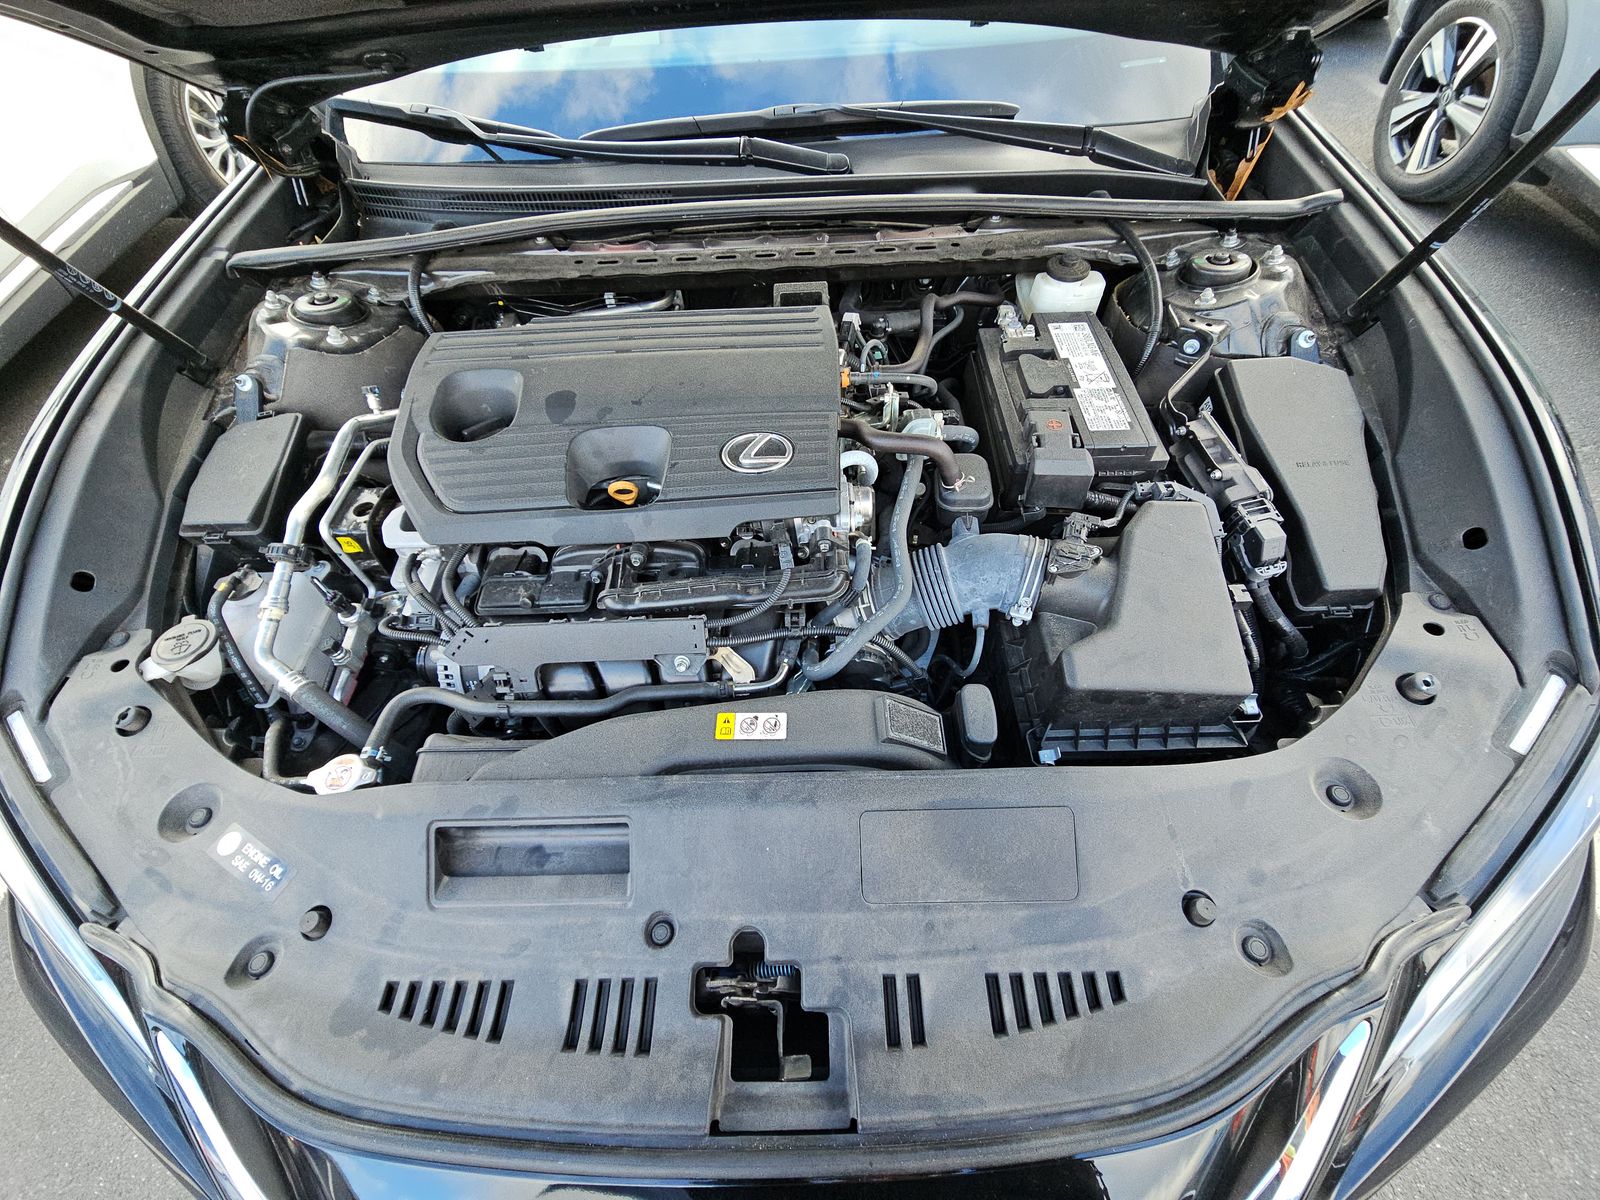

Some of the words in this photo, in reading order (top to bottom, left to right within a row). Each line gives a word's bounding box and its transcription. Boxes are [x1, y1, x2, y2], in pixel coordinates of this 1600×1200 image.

[1296, 460, 1321, 468] RELAY
[231, 854, 250, 873] SAE
[248, 868, 275, 892] 0W-16
[241, 842, 271, 869] ENGINE
[269, 863, 284, 881] OIL
